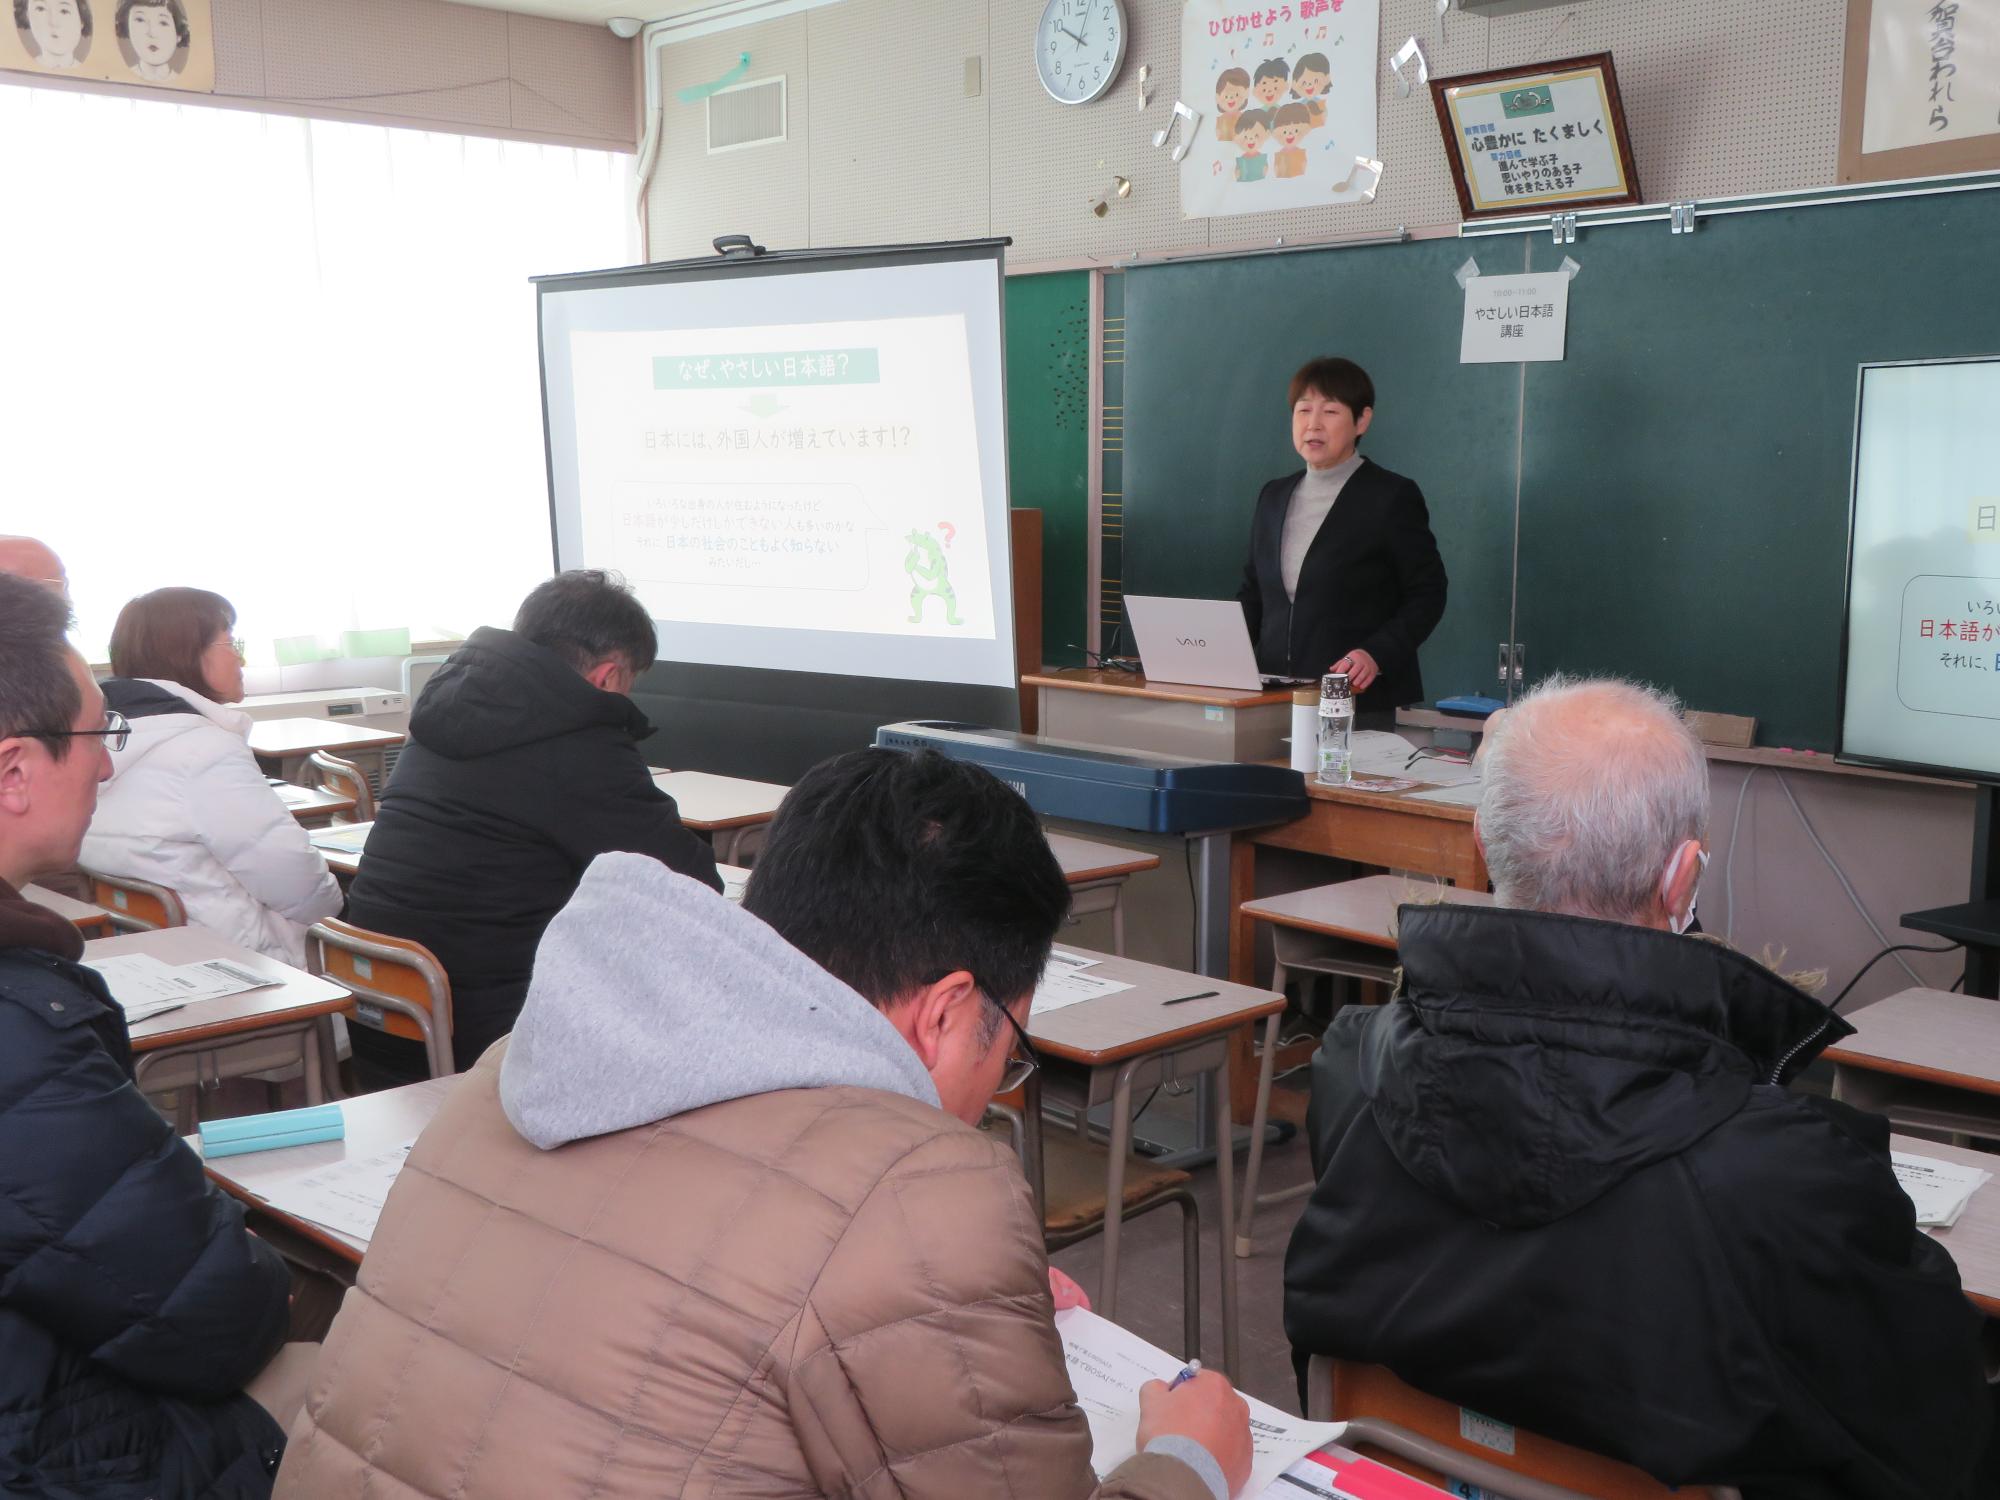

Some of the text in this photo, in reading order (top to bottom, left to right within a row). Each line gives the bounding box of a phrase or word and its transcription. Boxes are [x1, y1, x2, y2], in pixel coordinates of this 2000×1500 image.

[1062, 2, 1070, 16] 11
[1103, 6, 1110, 20] 2
[1053, 19, 1063, 33] 10
[1208, 5, 1292, 36] ひびかせよう
[1108, 27, 1115, 41] 3
[1050, 41, 1057, 55] 9
[1103, 51, 1110, 63] 4
[1055, 61, 1062, 75] 8
[1093, 66, 1100, 80] 5
[1066, 73, 1072, 86] 7
[1078, 75, 1085, 89] 6
[1471, 119, 1604, 152] 心豊かに たくましく
[1498, 153, 1559, 172] 進んで学ぶ子
[1501, 163, 1582, 183] 思いやりのある子
[1504, 176, 1575, 196] 体をきたえる子
[1474, 303, 1554, 320] やさしい日本語
[1500, 324, 1525, 338] 講座
[1176, 637, 1206, 648] VAIO
